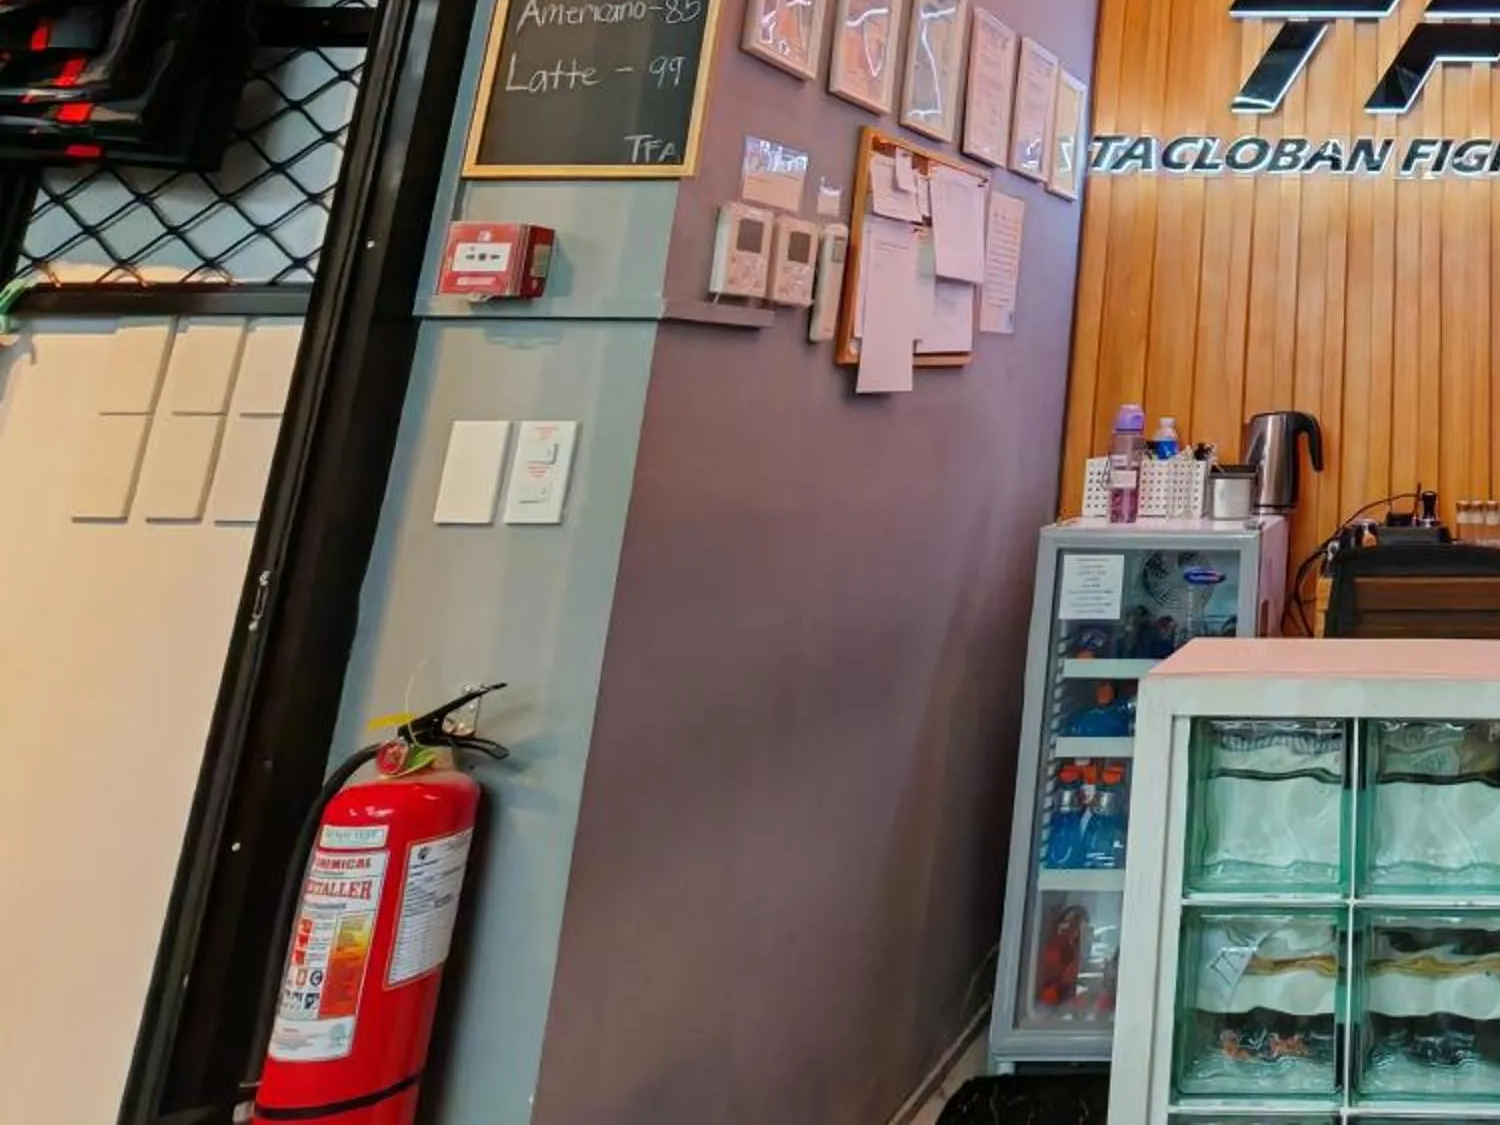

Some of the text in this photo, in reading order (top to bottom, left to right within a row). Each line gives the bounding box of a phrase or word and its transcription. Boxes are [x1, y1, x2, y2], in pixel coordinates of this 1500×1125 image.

[505, 53, 602, 93] Latte
[649, 55, 687, 89] 99
[623, 134, 677, 164] TFA
[1089, 134, 1395, 176] TACLOBAN
